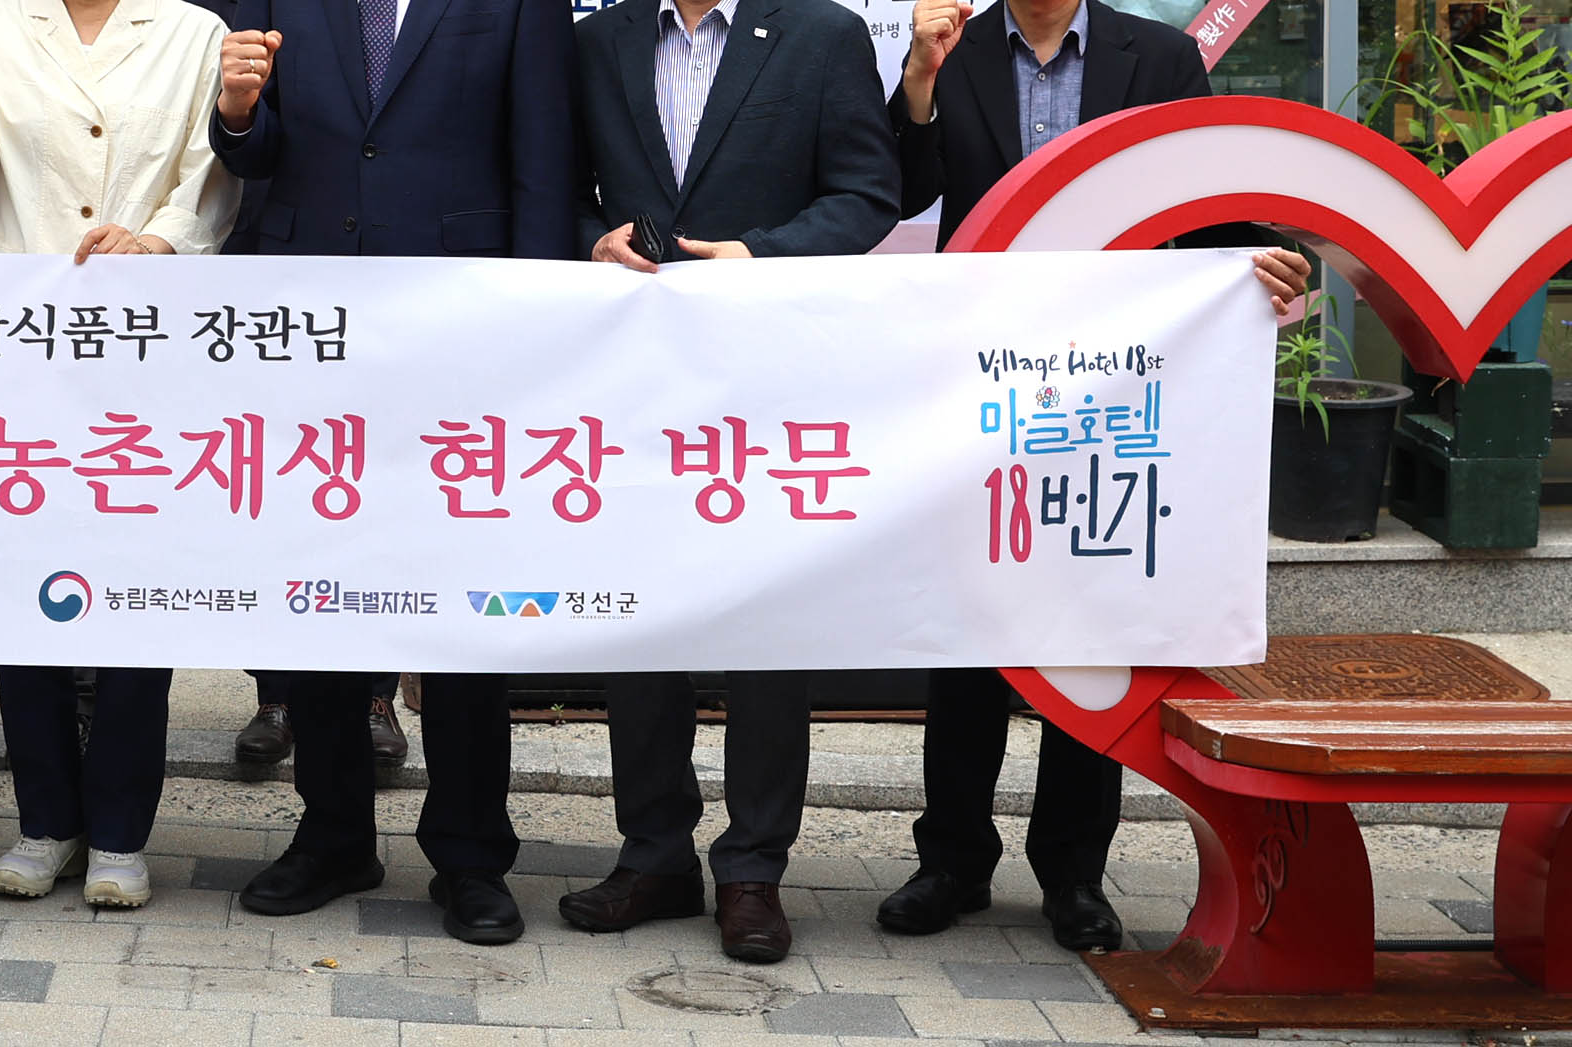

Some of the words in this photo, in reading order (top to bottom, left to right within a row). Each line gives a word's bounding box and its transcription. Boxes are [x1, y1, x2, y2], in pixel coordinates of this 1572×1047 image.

[190, 305, 347, 363] 장관님
[978, 349, 1061, 382] Village
[1068, 350, 1119, 376] Hotel
[980, 380, 1172, 459] 마을호텔
[419, 415, 625, 523] 현장
[661, 416, 871, 524] 방문
[984, 454, 1172, 578] 18번가
[105, 587, 258, 612] 농림축산식품부
[285, 579, 438, 614] 강원특별자치도
[565, 591, 639, 614] 정선군
